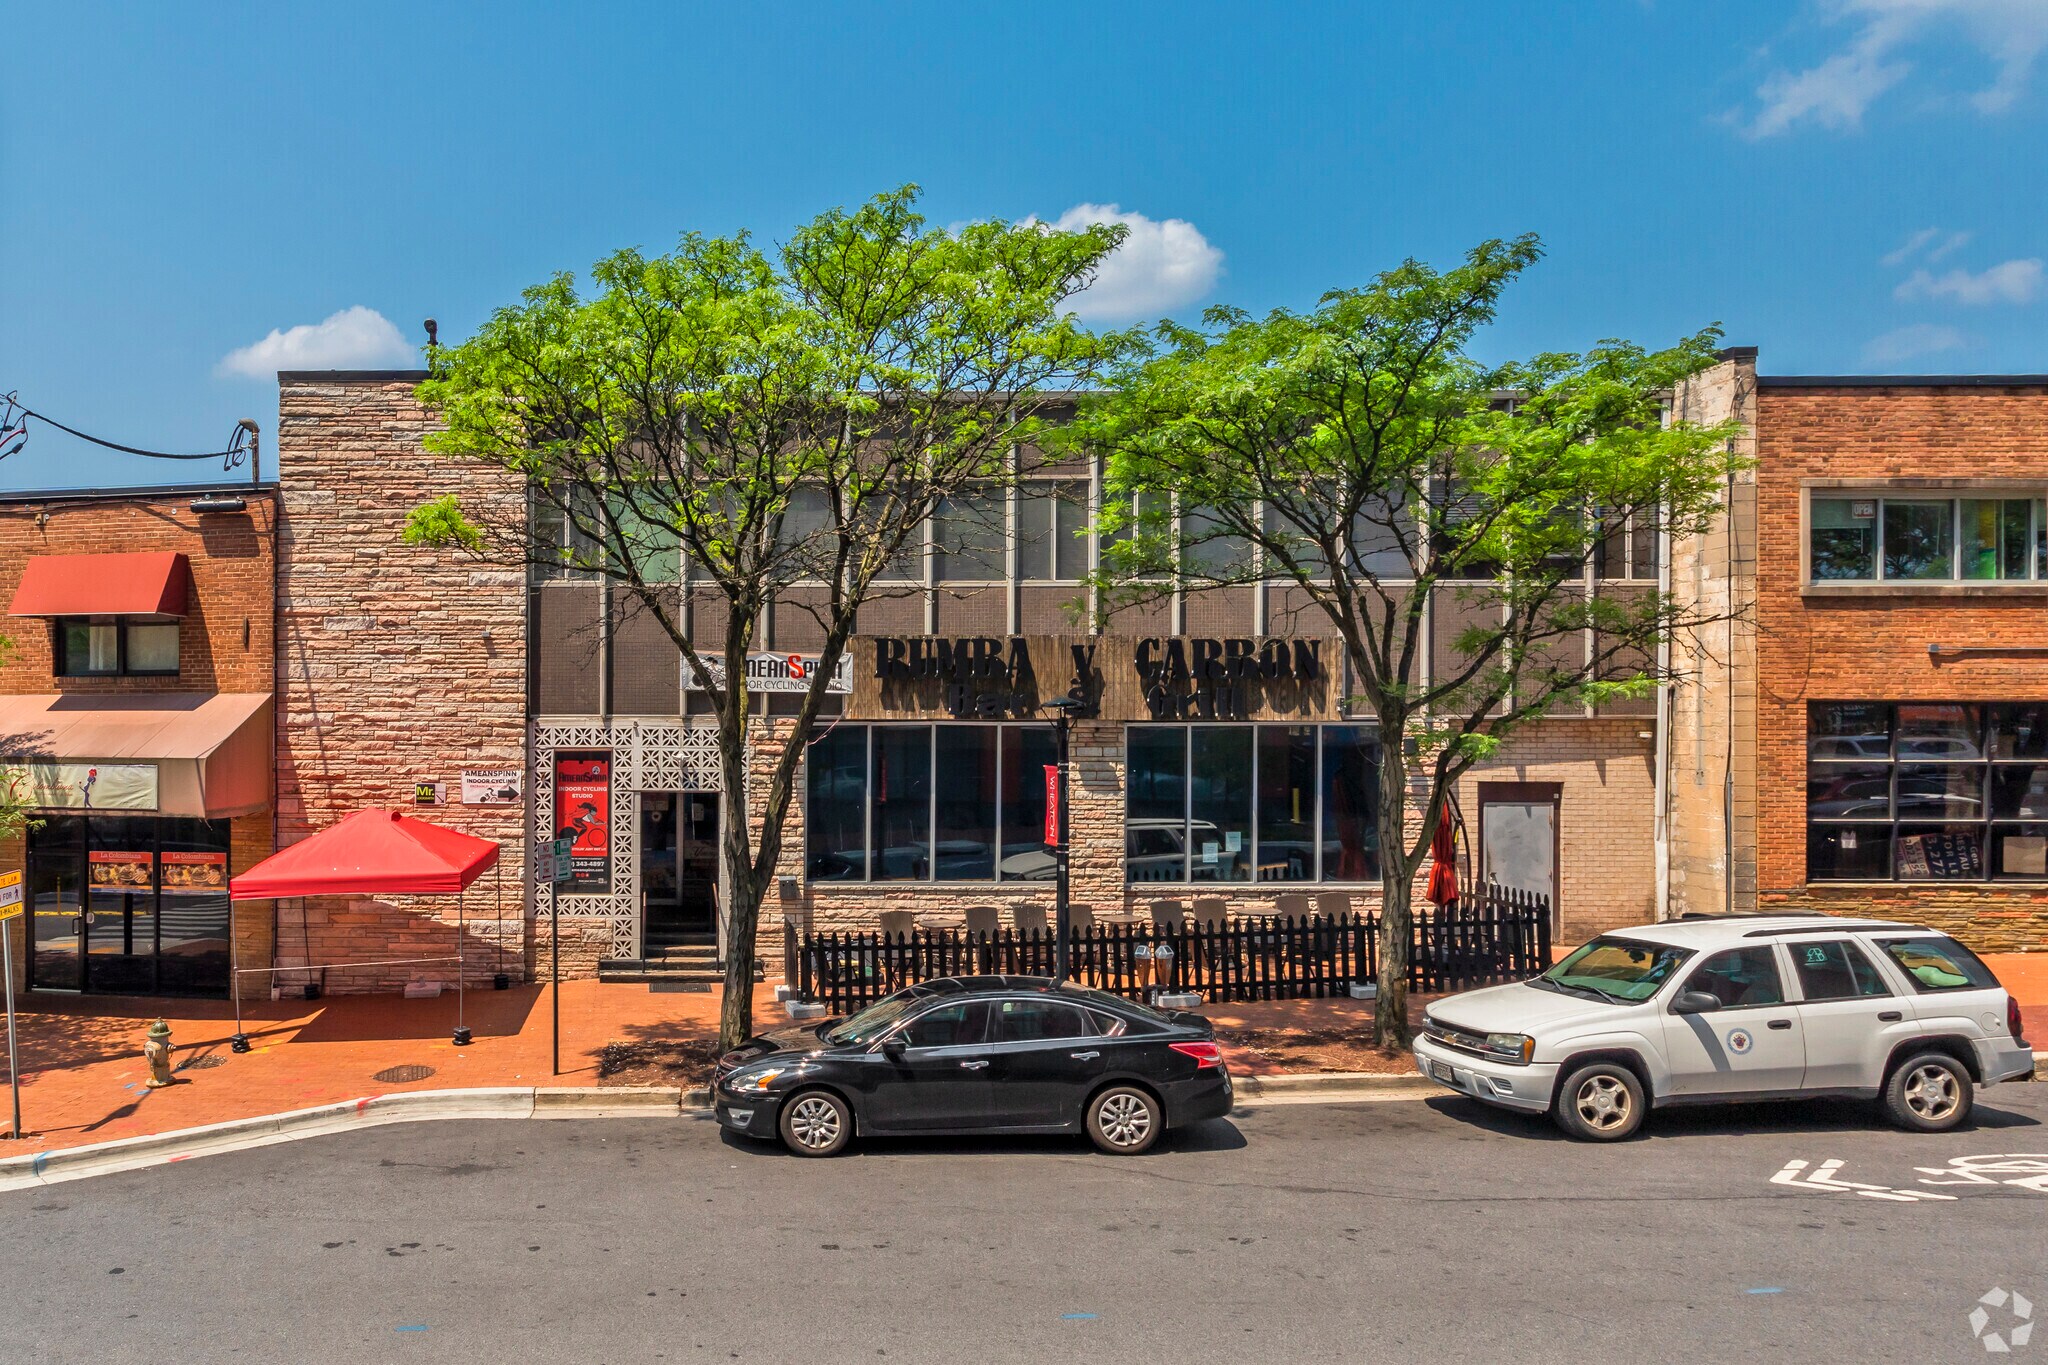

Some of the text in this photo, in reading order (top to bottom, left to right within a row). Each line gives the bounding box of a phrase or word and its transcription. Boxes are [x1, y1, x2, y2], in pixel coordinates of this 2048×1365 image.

[1854, 503, 1873, 515] OPEN
[874, 638, 1029, 679] RUMBA
[1135, 638, 1322, 680] CARBON
[764, 681, 804, 690] CYCLING
[1147, 683, 1245, 717] Grill
[416, 786, 435, 796] Mr.
[1943, 834, 1954, 857] FOR
[2, 891, 12, 901] FOR
